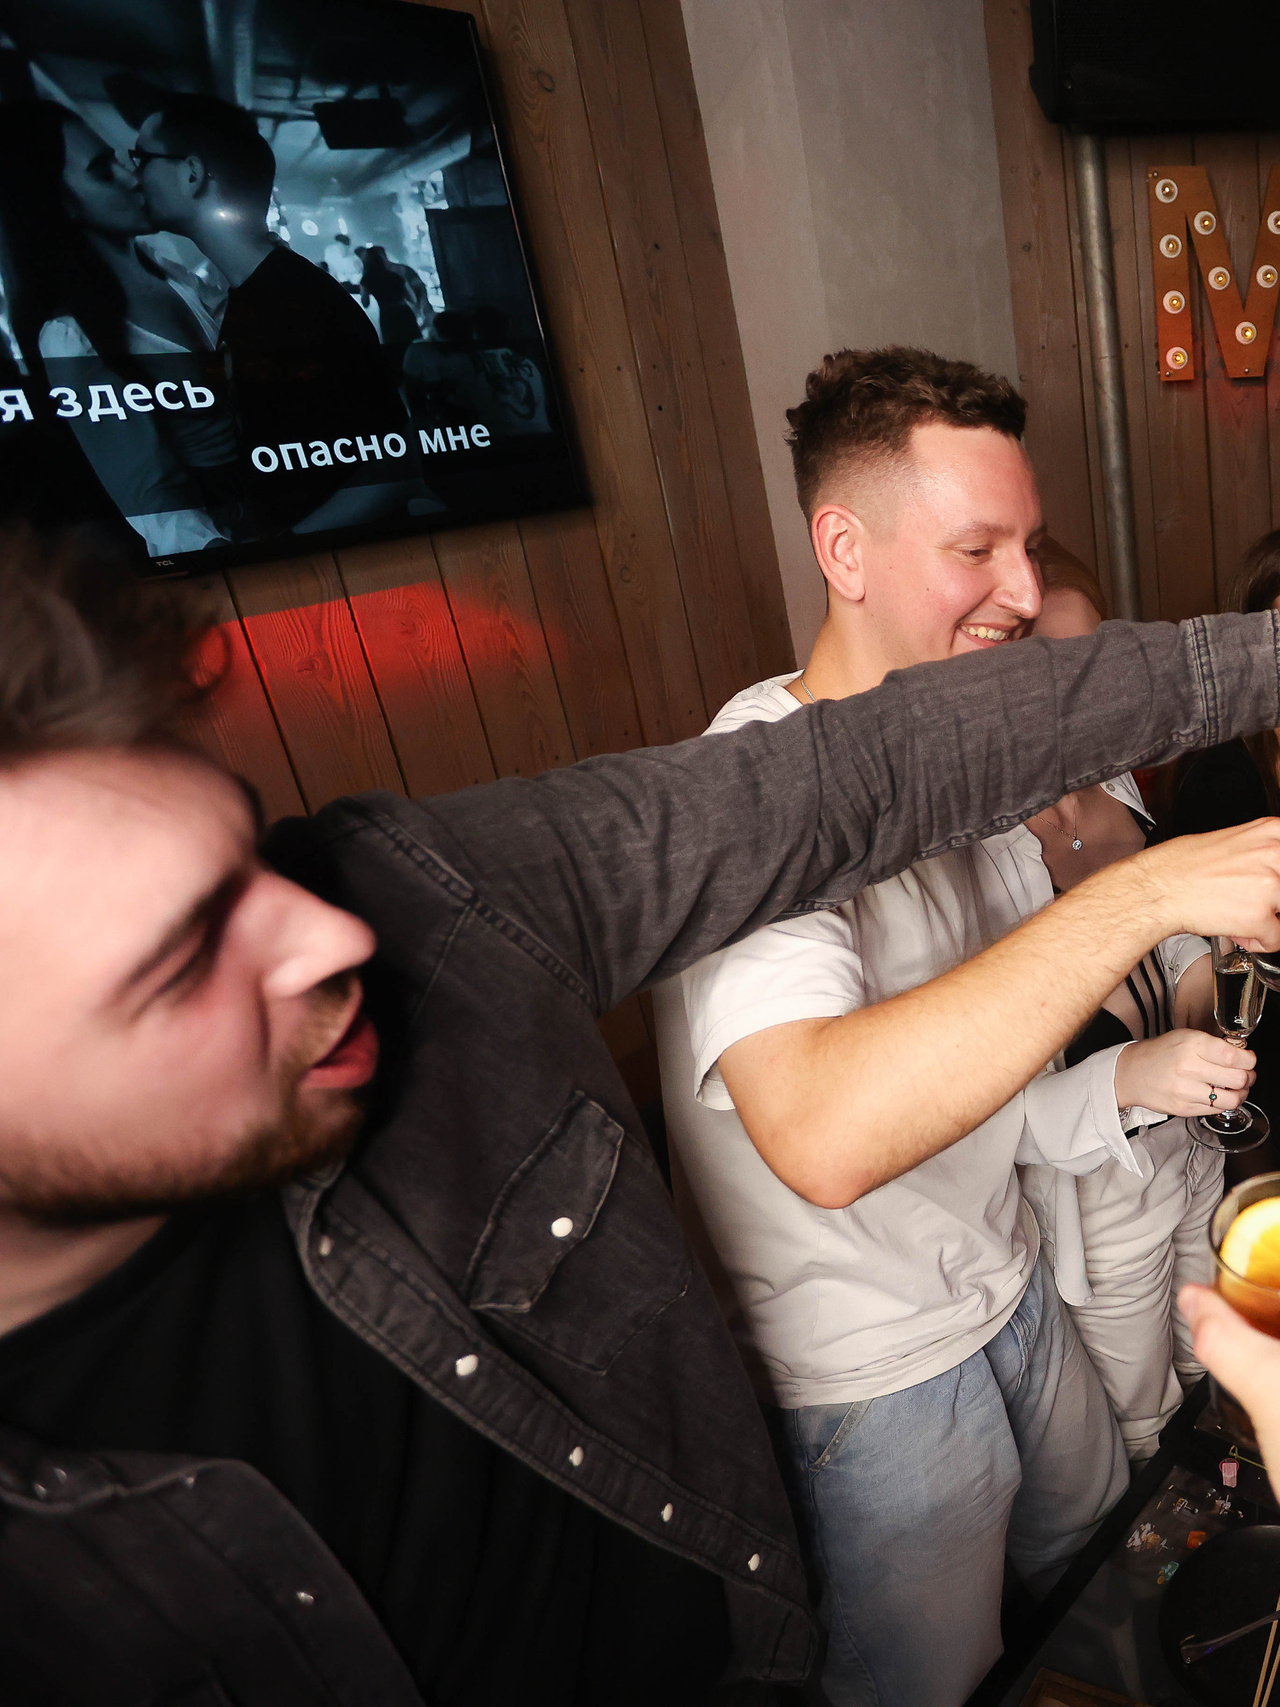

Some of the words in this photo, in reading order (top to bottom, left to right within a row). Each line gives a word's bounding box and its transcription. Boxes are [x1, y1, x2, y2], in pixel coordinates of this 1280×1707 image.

[49, 380, 215, 423] здесь
[251, 432, 408, 473] опасно
[418, 423, 492, 455] мне
[154, 559, 175, 567] TCL
